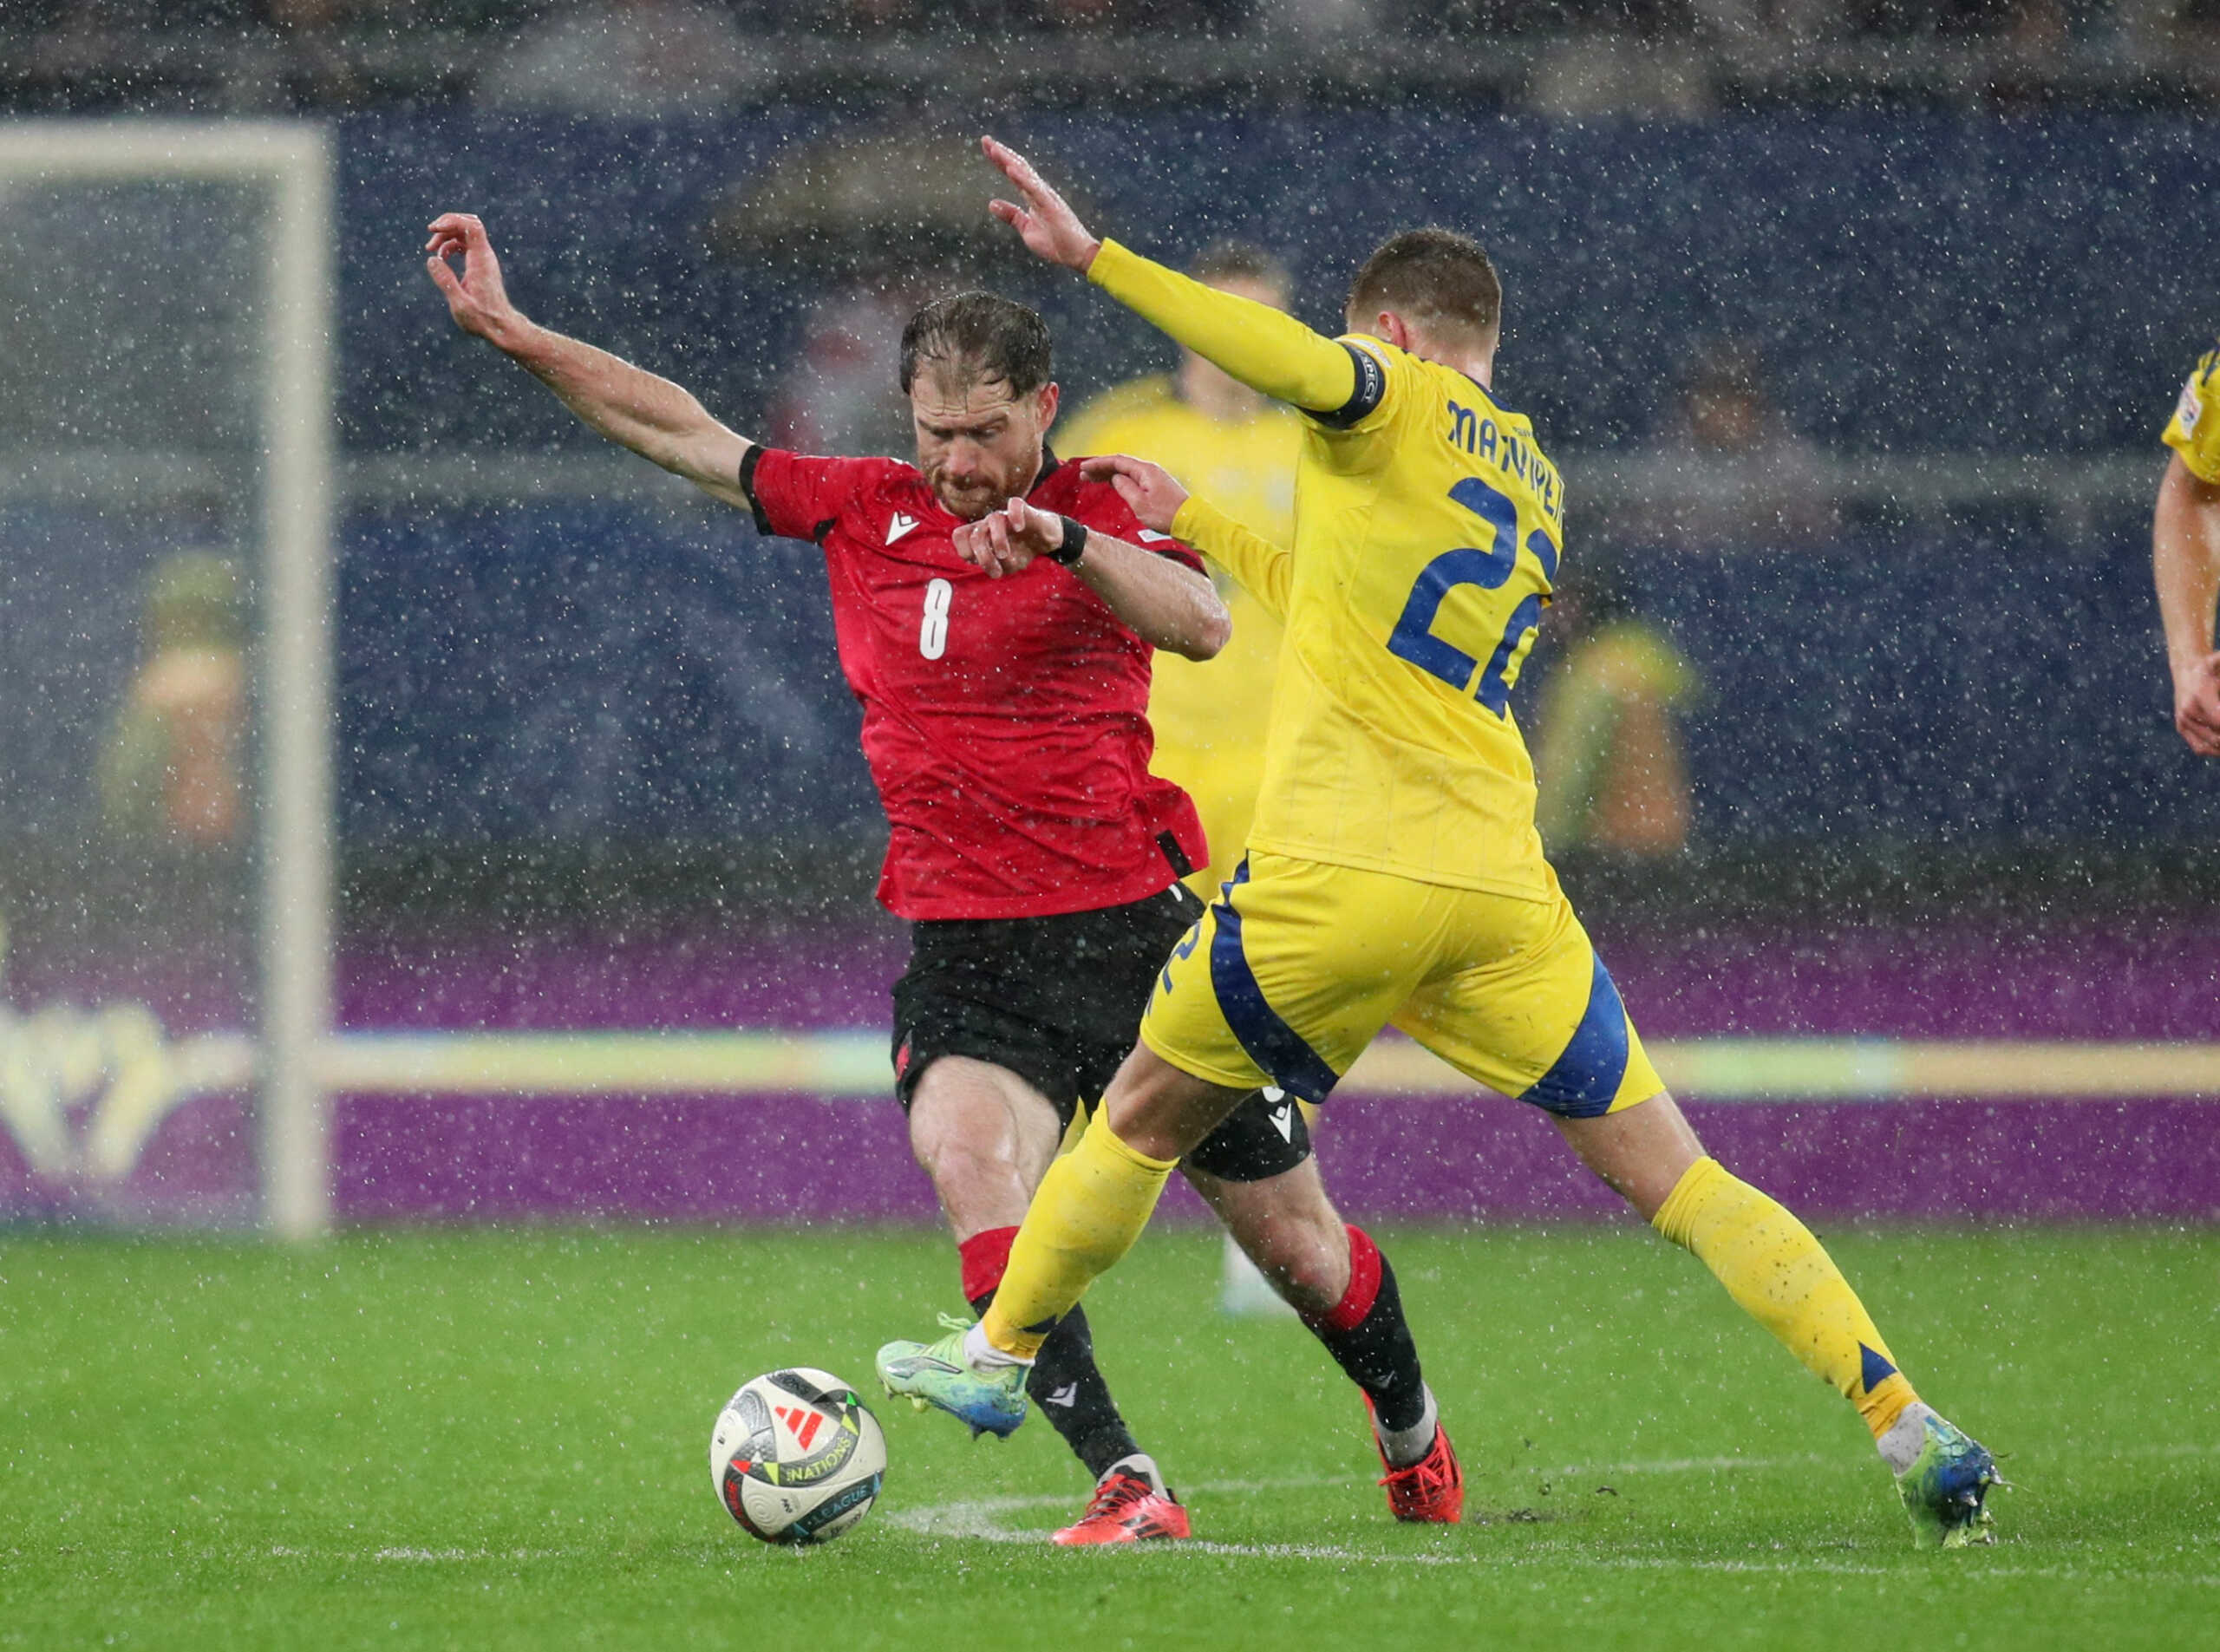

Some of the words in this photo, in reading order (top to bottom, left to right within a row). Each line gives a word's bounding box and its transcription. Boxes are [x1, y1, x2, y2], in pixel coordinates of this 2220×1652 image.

[919, 578, 953, 660] 8
[791, 1436, 852, 1481] NATIONS
[812, 1485, 868, 1525] LEAGUE
